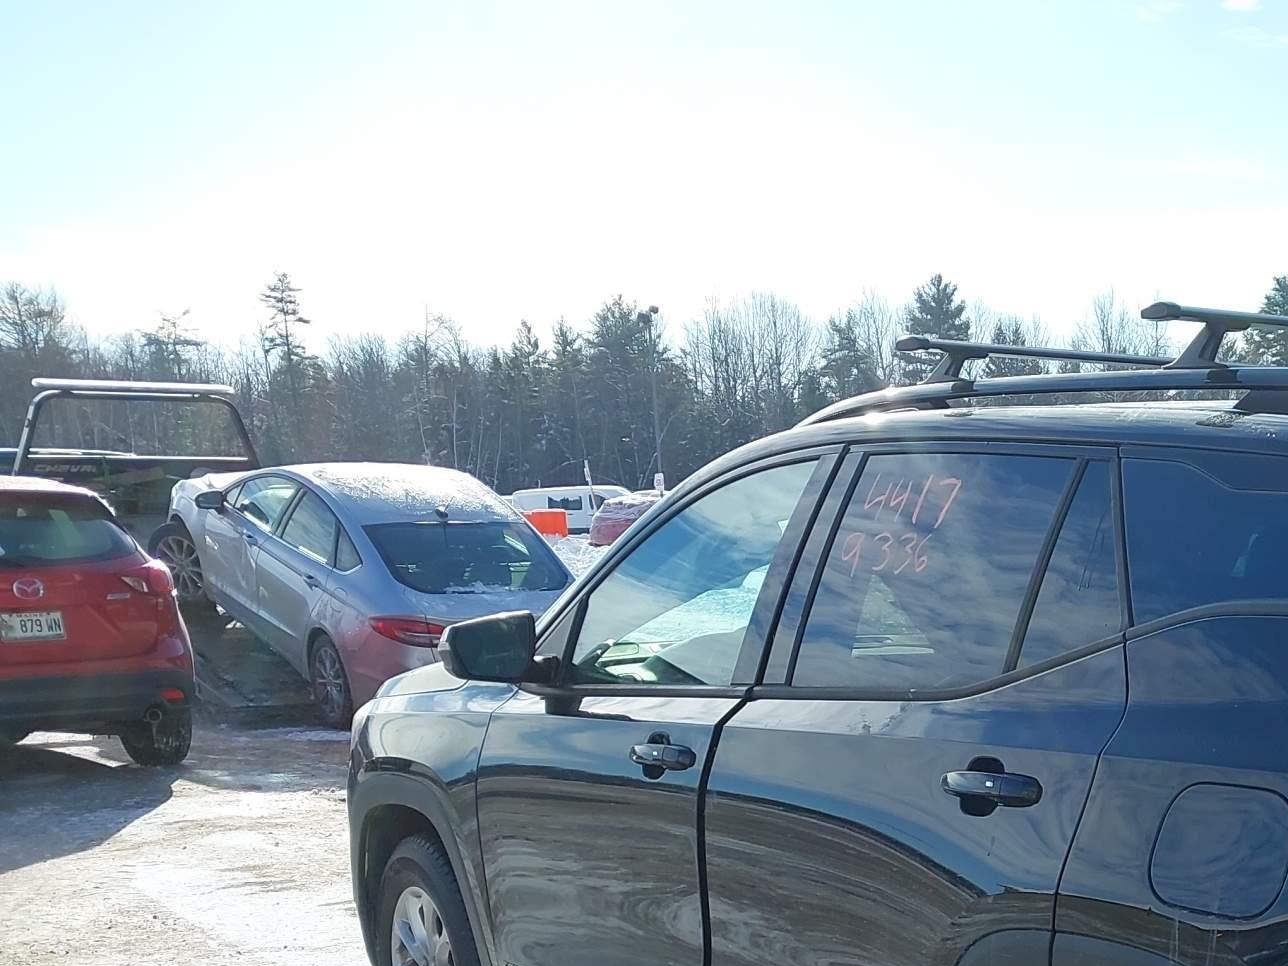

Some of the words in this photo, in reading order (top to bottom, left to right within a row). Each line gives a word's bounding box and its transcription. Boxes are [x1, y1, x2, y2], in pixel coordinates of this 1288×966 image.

[864, 473, 961, 529] 4417
[841, 532, 932, 577] 9336
[20, 618, 43, 633] 879
